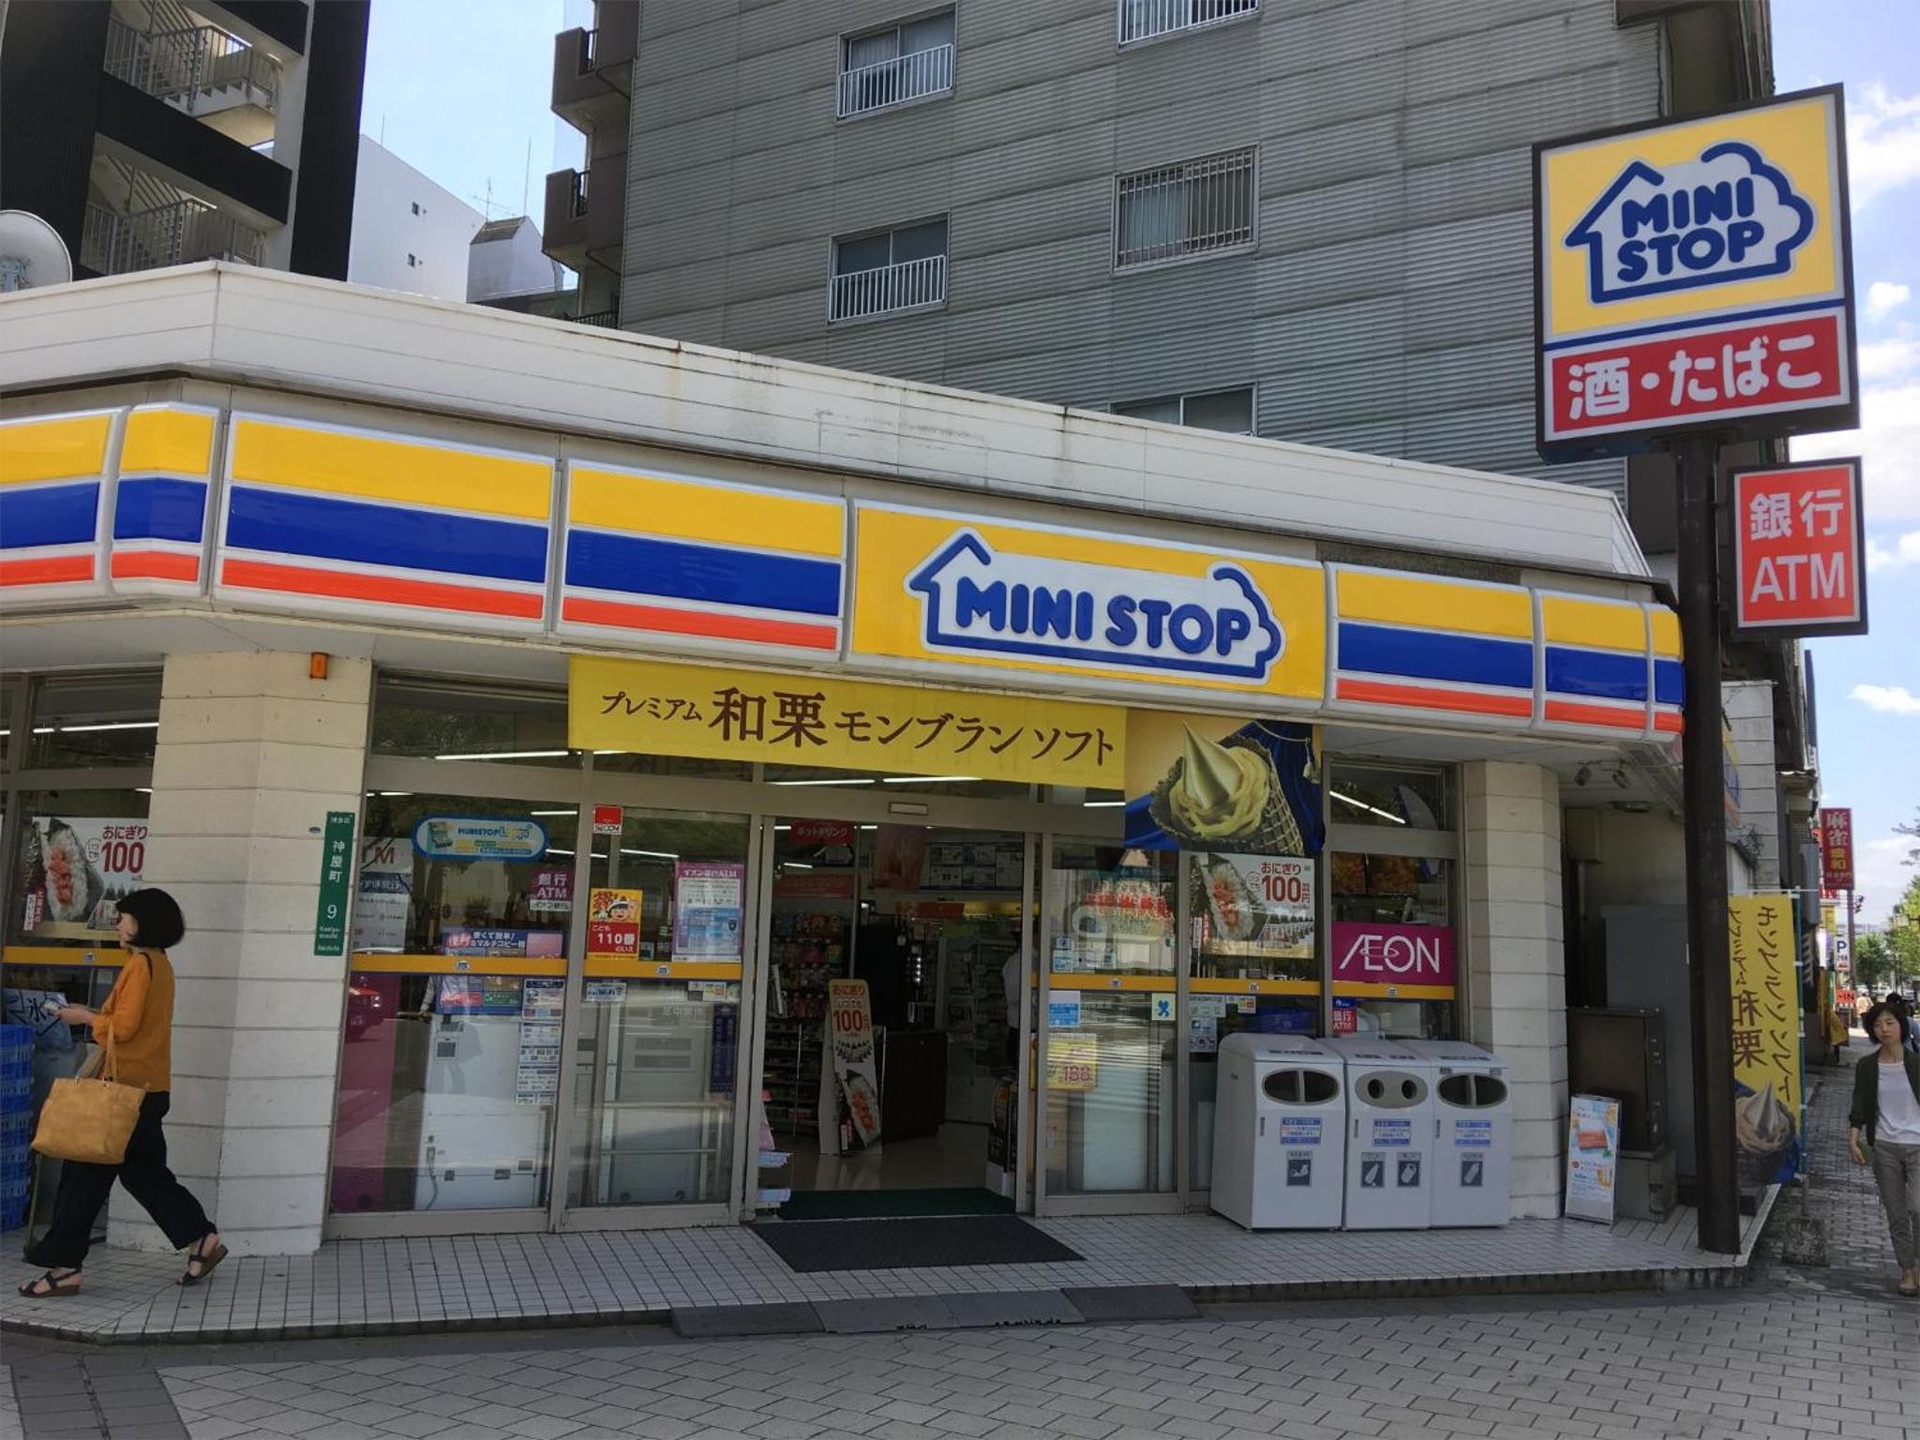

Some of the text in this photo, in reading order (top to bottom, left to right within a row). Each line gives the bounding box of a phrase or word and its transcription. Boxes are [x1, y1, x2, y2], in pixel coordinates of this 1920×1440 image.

[1621, 176, 1755, 238] MINI
[1617, 219, 1764, 283] STOP
[1568, 335, 1822, 420] 酒・たばこ
[1750, 488, 1844, 540] 銀行
[1750, 552, 1846, 603] ATM
[955, 576, 1251, 657] MINI STOP
[102, 825, 148, 840] おにぎり
[101, 842, 145, 873] 100
[328, 841, 345, 882] 神屋町
[1261, 861, 1301, 875] おにぎり
[538, 873, 567, 887] 銀行
[1261, 875, 1301, 903] 100
[537, 887, 567, 899] ATM
[327, 905, 337, 919] 9
[598, 933, 635, 945] 110番
[1837, 941, 1847, 953] P
[832, 984, 865, 996] おにぎり
[833, 1010, 863, 1033] 100
